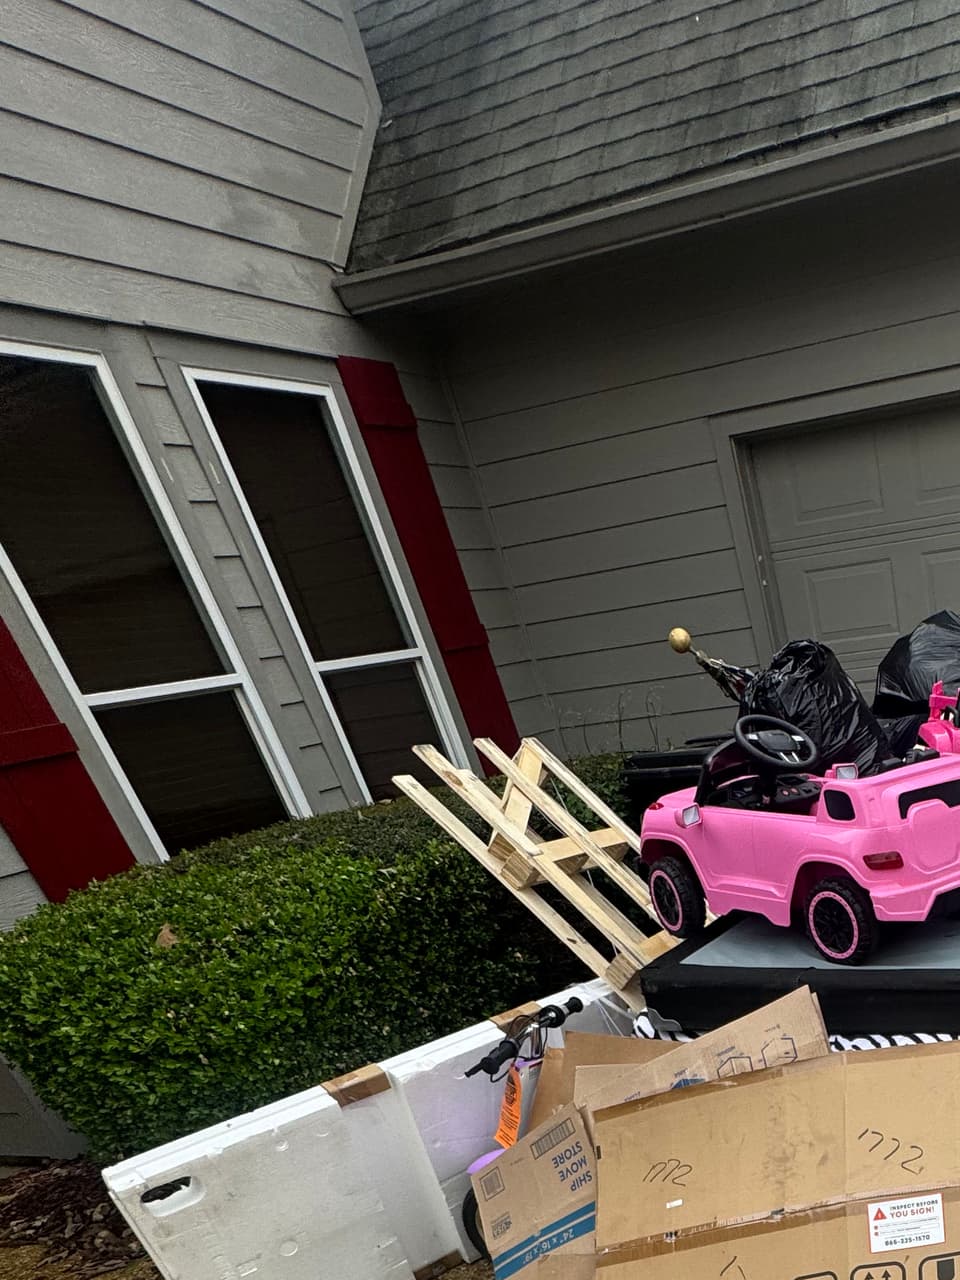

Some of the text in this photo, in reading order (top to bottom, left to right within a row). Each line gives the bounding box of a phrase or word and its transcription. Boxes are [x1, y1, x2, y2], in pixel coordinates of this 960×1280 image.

[552, 1141, 583, 1169] STORE
[857, 1128, 924, 1175] 1772
[558, 1156, 588, 1182] MOVE
[570, 1170, 593, 1192] SHIP
[890, 1199, 938, 1211] INSPECT BEFORE
[890, 1207, 935, 1219] YOU SIGN!
